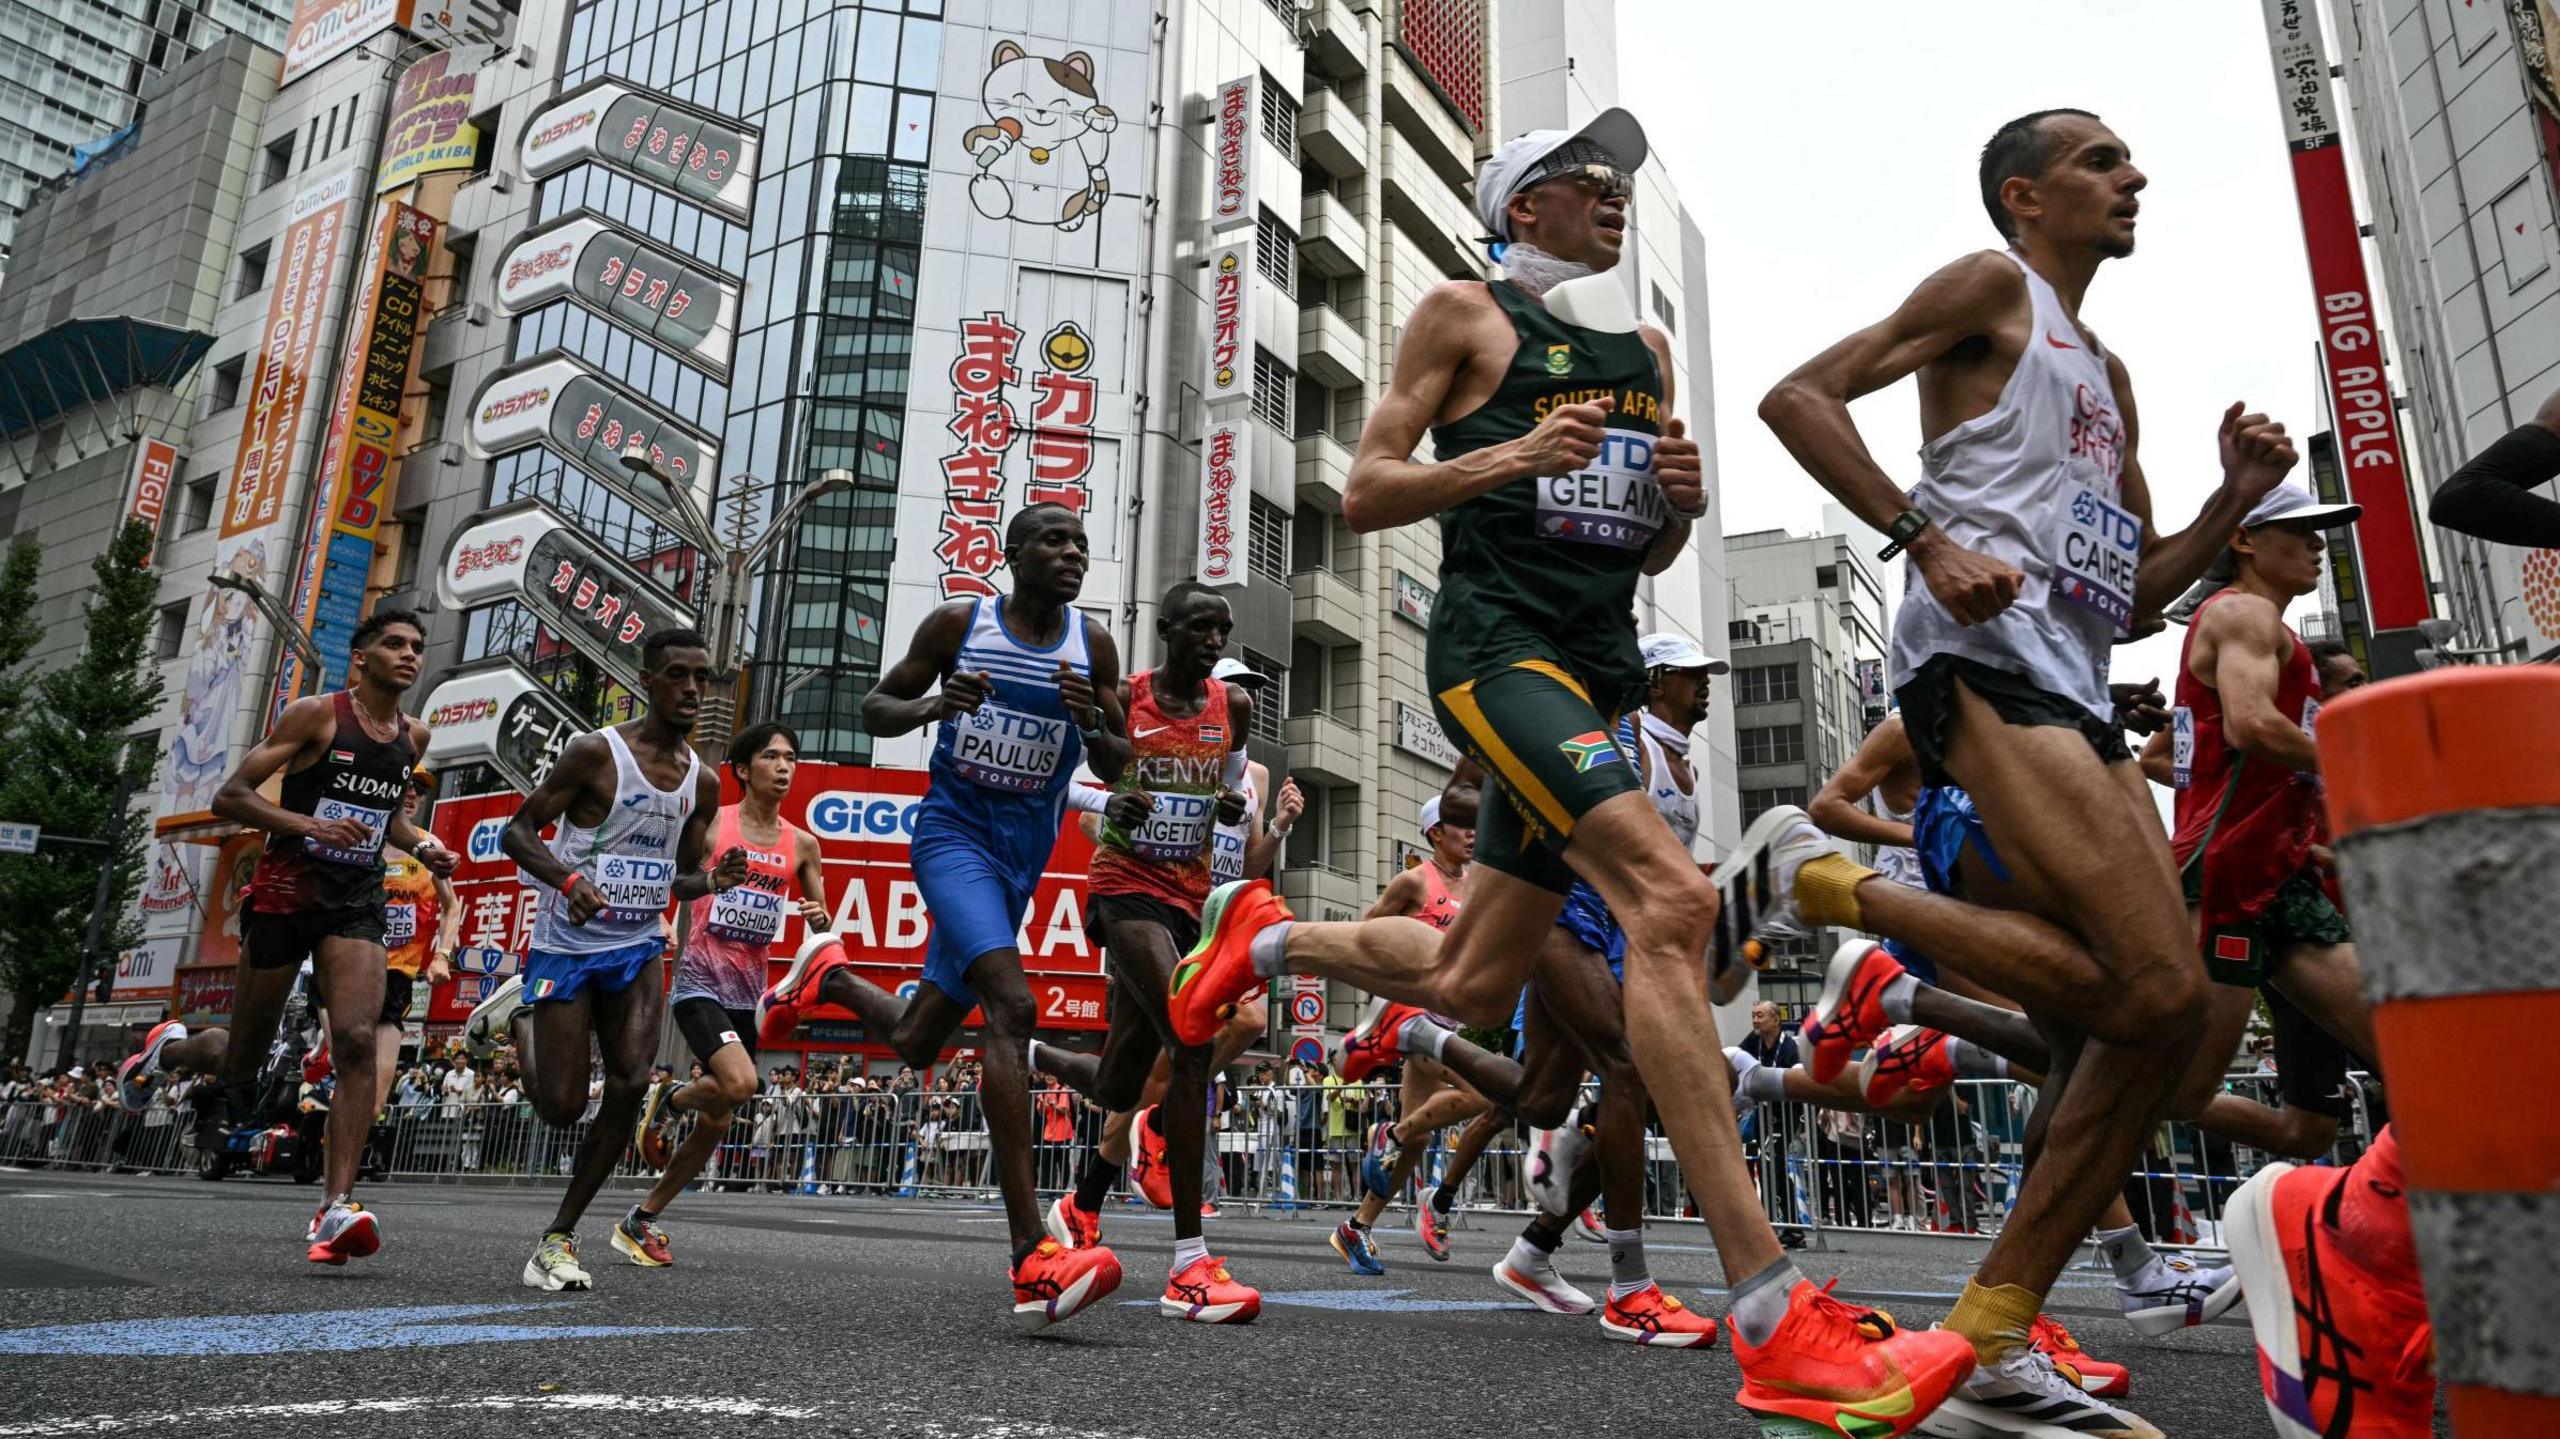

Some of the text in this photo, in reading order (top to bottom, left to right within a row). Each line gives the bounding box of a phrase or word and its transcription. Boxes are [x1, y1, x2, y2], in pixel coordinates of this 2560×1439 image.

[297, 0, 393, 51] amiam
[540, 114, 588, 146] カラオケ
[2305, 137, 2325, 150] 5F
[428, 144, 472, 160] AKIBA
[624, 115, 730, 181] まねきねこ
[1218, 82, 1247, 217] まねきねこ
[294, 178, 346, 214] amiami
[398, 210, 432, 236] 激安
[505, 243, 573, 291] まねきねこ
[387, 276, 419, 300] ゲーム
[600, 256, 691, 318] カラオケ
[385, 297, 413, 317] CD
[378, 313, 414, 338] アイドル
[1214, 274, 1240, 369] カラオケ
[373, 332, 411, 355] アニメ
[369, 352, 405, 374] コミック
[368, 373, 399, 392] ホビー
[2323, 291, 2394, 468] BIG APPLE
[362, 390, 398, 411] フィギュア
[490, 388, 542, 426] カラオケ
[340, 443, 388, 530] DVD
[1204, 427, 1237, 578] まねきねこ
[454, 536, 524, 581] まねきねこ
[551, 560, 646, 644] カラオケ
[439, 699, 489, 728] カラオケ
[995, 712, 1061, 745] TDK
[961, 734, 1055, 775] PAULUS
[1136, 757, 1220, 785] KENYA
[332, 772, 402, 800] SUDAN
[1164, 795, 1213, 818] TDK
[628, 833, 668, 850] ITALIA
[162, 865, 184, 892] 1st
[626, 860, 676, 882] TDK
[140, 889, 196, 913] Anniversary
[738, 890, 781, 913] TDK
[716, 905, 778, 934] YOSHIDA
[485, 953, 500, 968] 17
[1045, 986, 1099, 1019] 2号館
